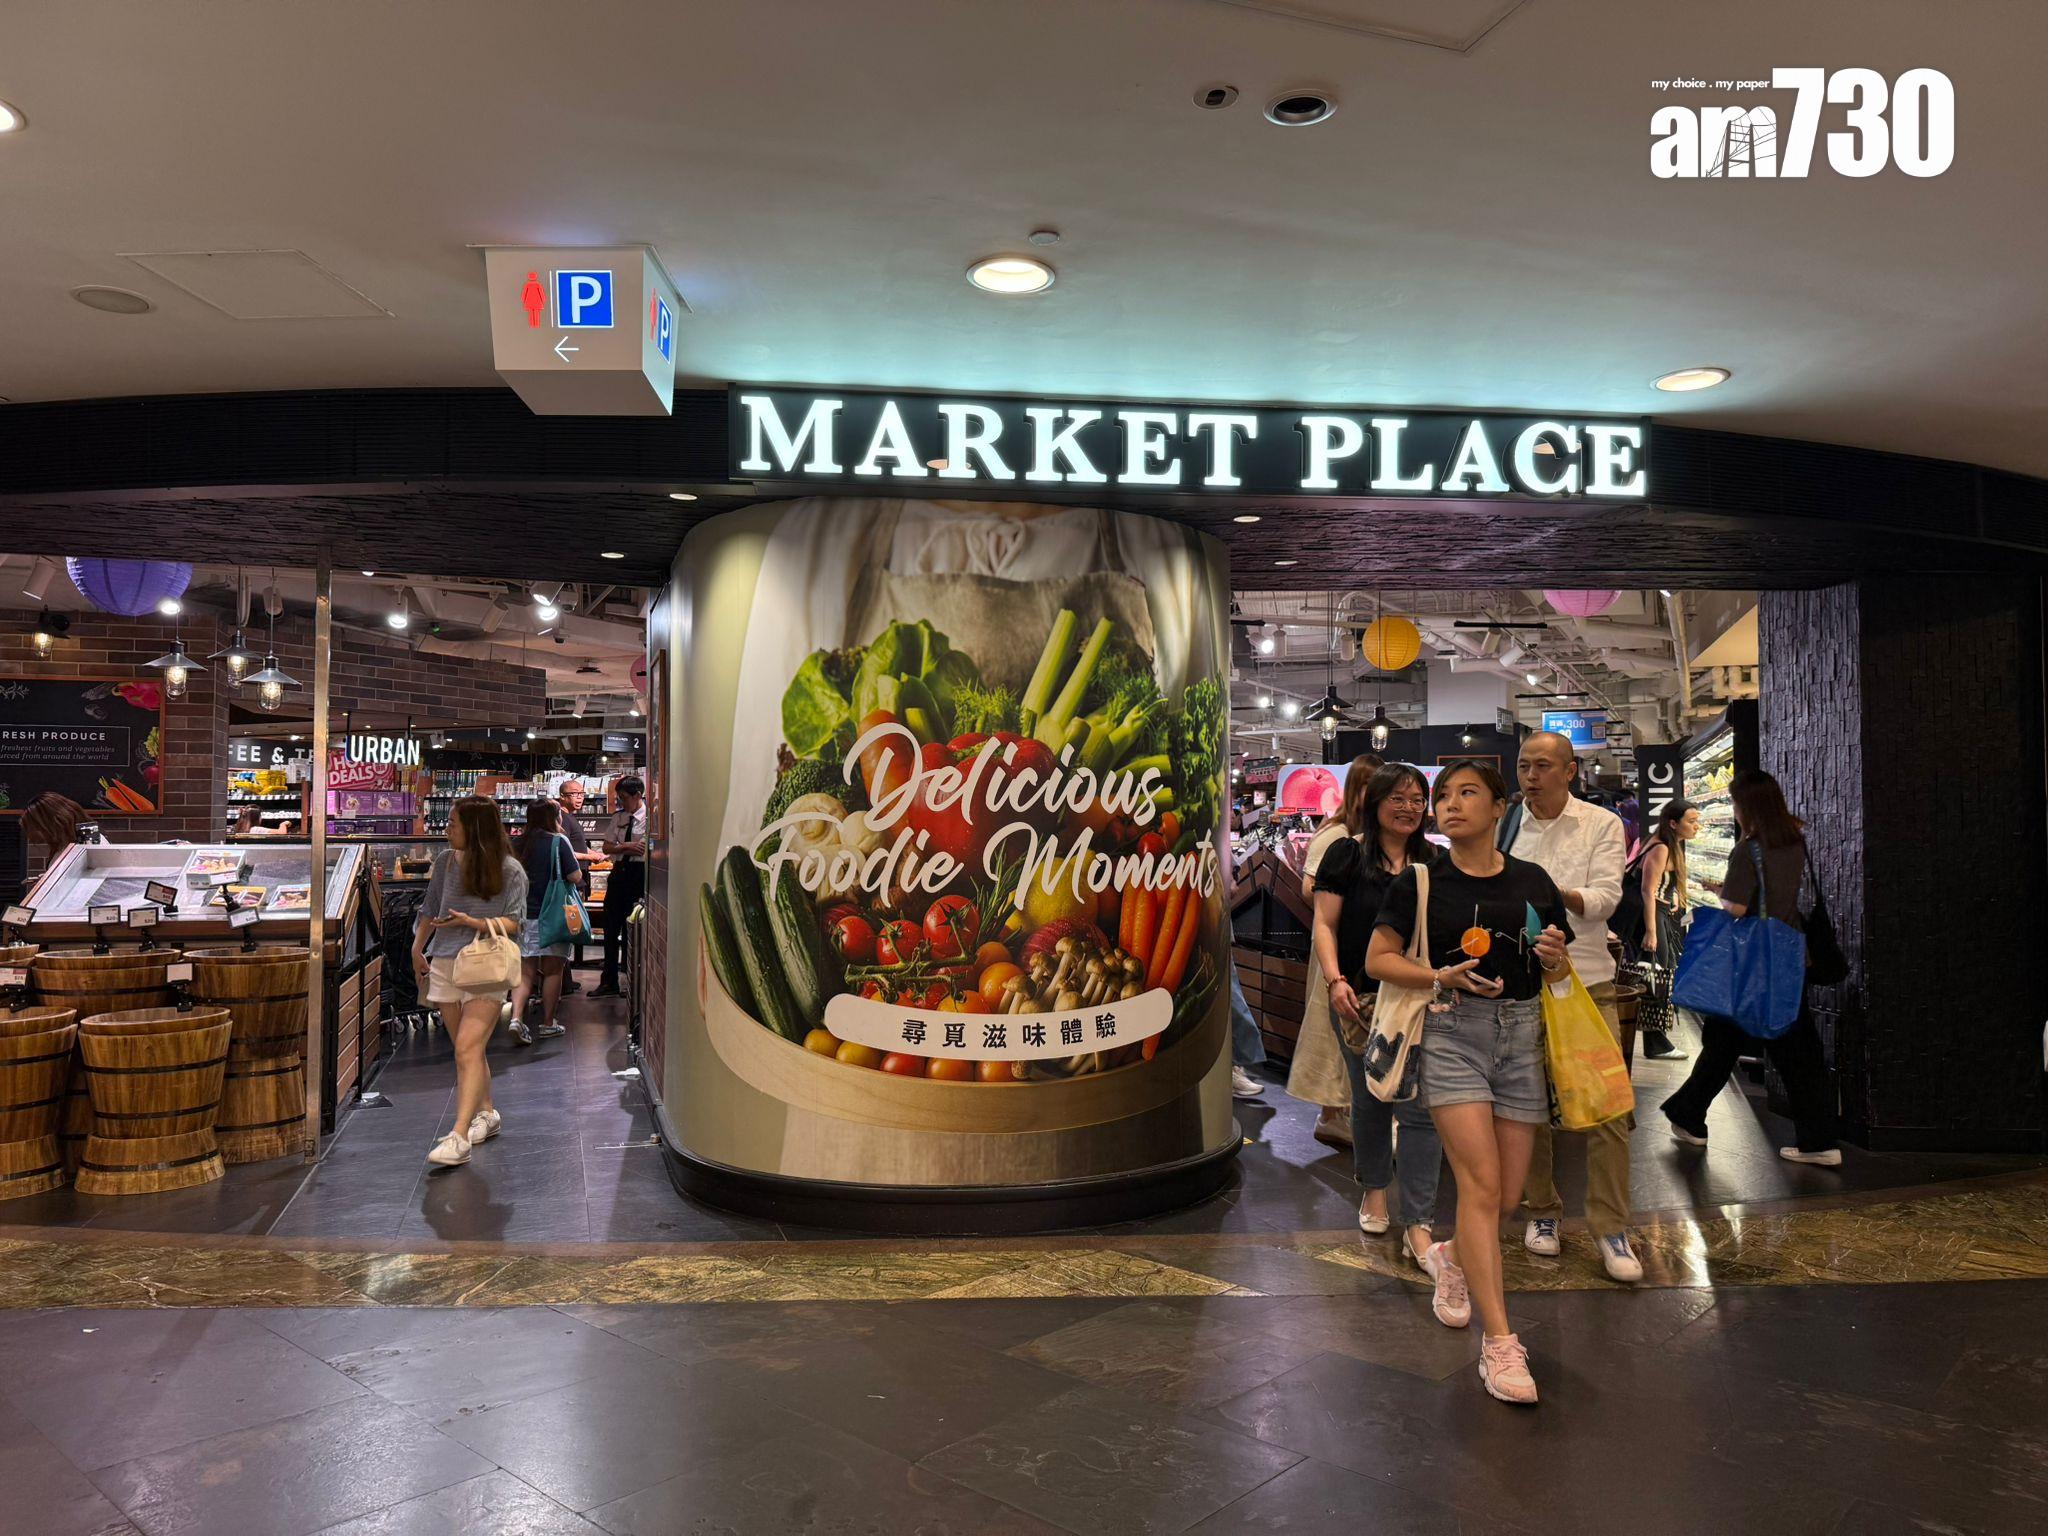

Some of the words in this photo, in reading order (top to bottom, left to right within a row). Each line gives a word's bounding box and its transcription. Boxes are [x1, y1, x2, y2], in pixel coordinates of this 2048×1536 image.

[570, 275, 602, 324] P
[740, 395, 1257, 487] MARKET
[1300, 416, 1646, 498] PLACE
[34, 744, 56, 753] fruits
[75, 745, 115, 754] vegetables
[42, 731, 106, 741] PRODUCE
[350, 734, 420, 766] URBAN
[633, 737, 640, 749] 2
[21, 752, 41, 761] from
[42, 752, 71, 760] around
[72, 752, 86, 760] the
[87, 752, 110, 761] world
[271, 746, 285, 764] &
[328, 765, 375, 786] DEALS
[841, 721, 1164, 832] Delicious
[1647, 762, 1674, 834] NIC
[748, 811, 965, 908] Foodie
[982, 821, 1219, 911] Moments
[901, 1011, 1117, 1049] 尋覓滋味體驗
